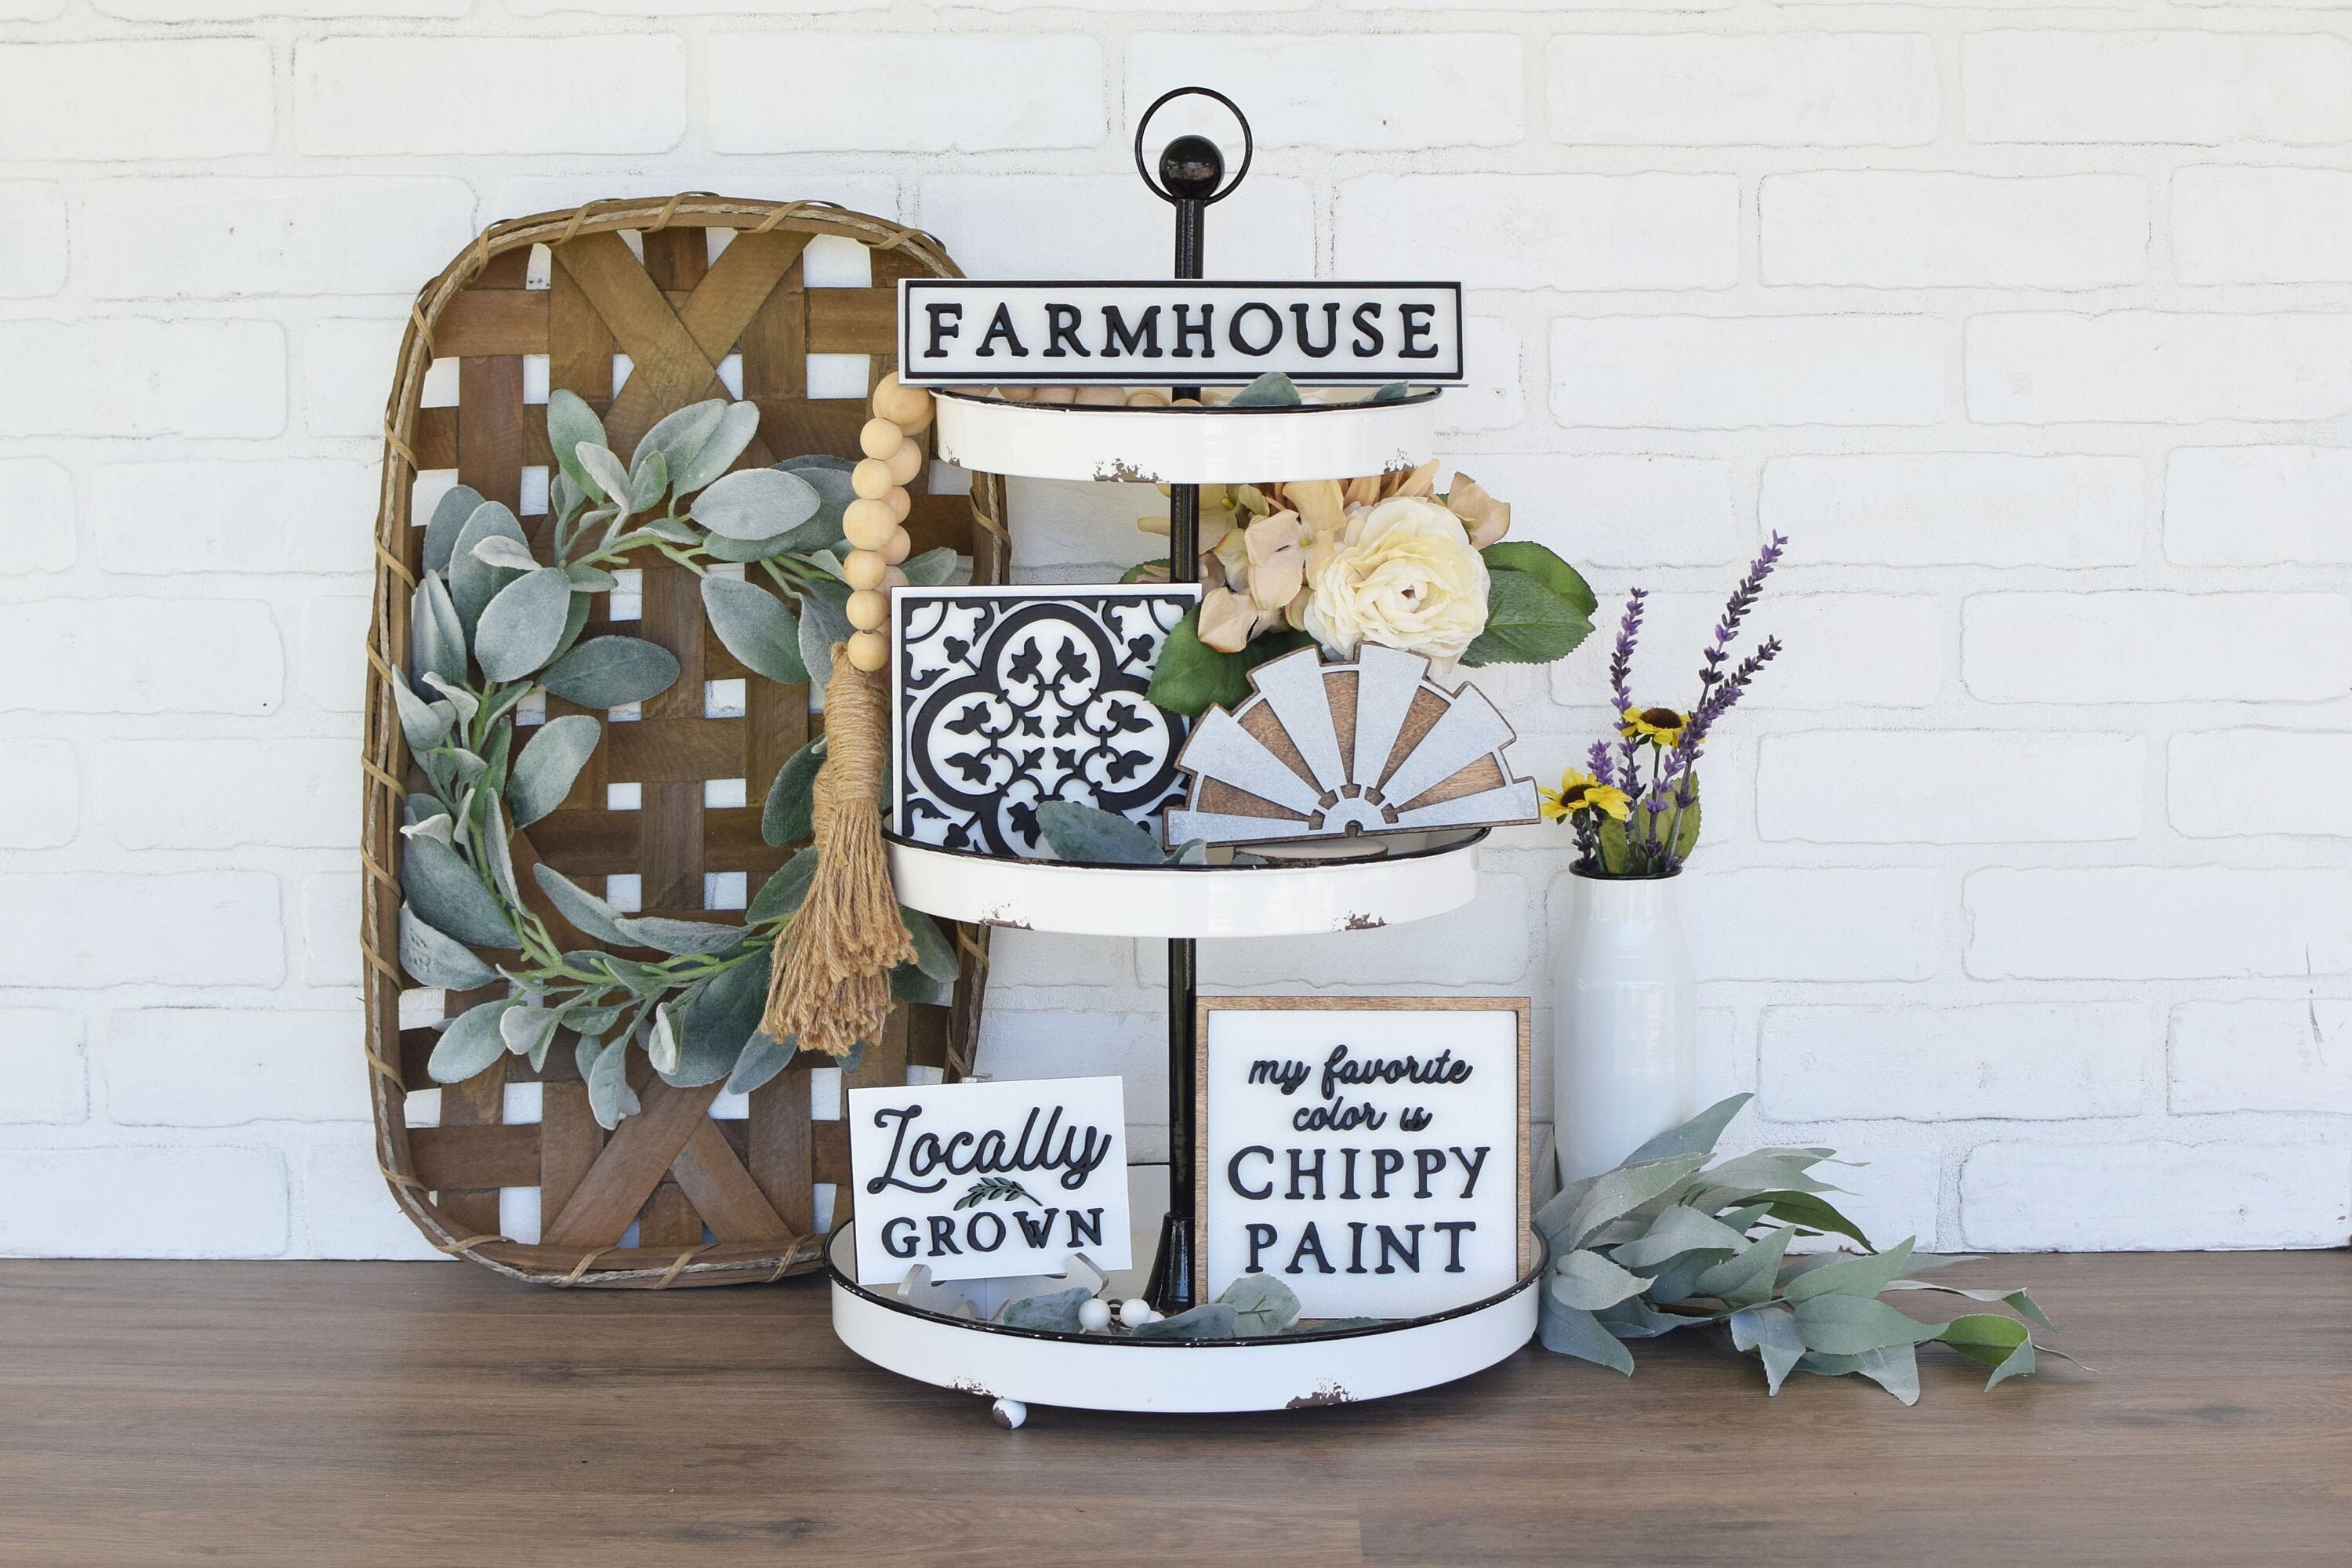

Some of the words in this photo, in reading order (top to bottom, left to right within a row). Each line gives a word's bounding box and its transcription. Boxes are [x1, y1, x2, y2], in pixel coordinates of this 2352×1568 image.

[923, 301, 1439, 358] FARMHOUSE
[1247, 1058, 1312, 1096] my
[1321, 1044, 1474, 1101] favorite
[1292, 1095, 1388, 1133] color
[1399, 1106, 1433, 1133] is
[866, 1104, 1112, 1196] Locally
[1227, 1145, 1491, 1201] CHIPPY
[880, 1207, 1105, 1259] GROWN
[1244, 1220, 1477, 1275] PAINT
